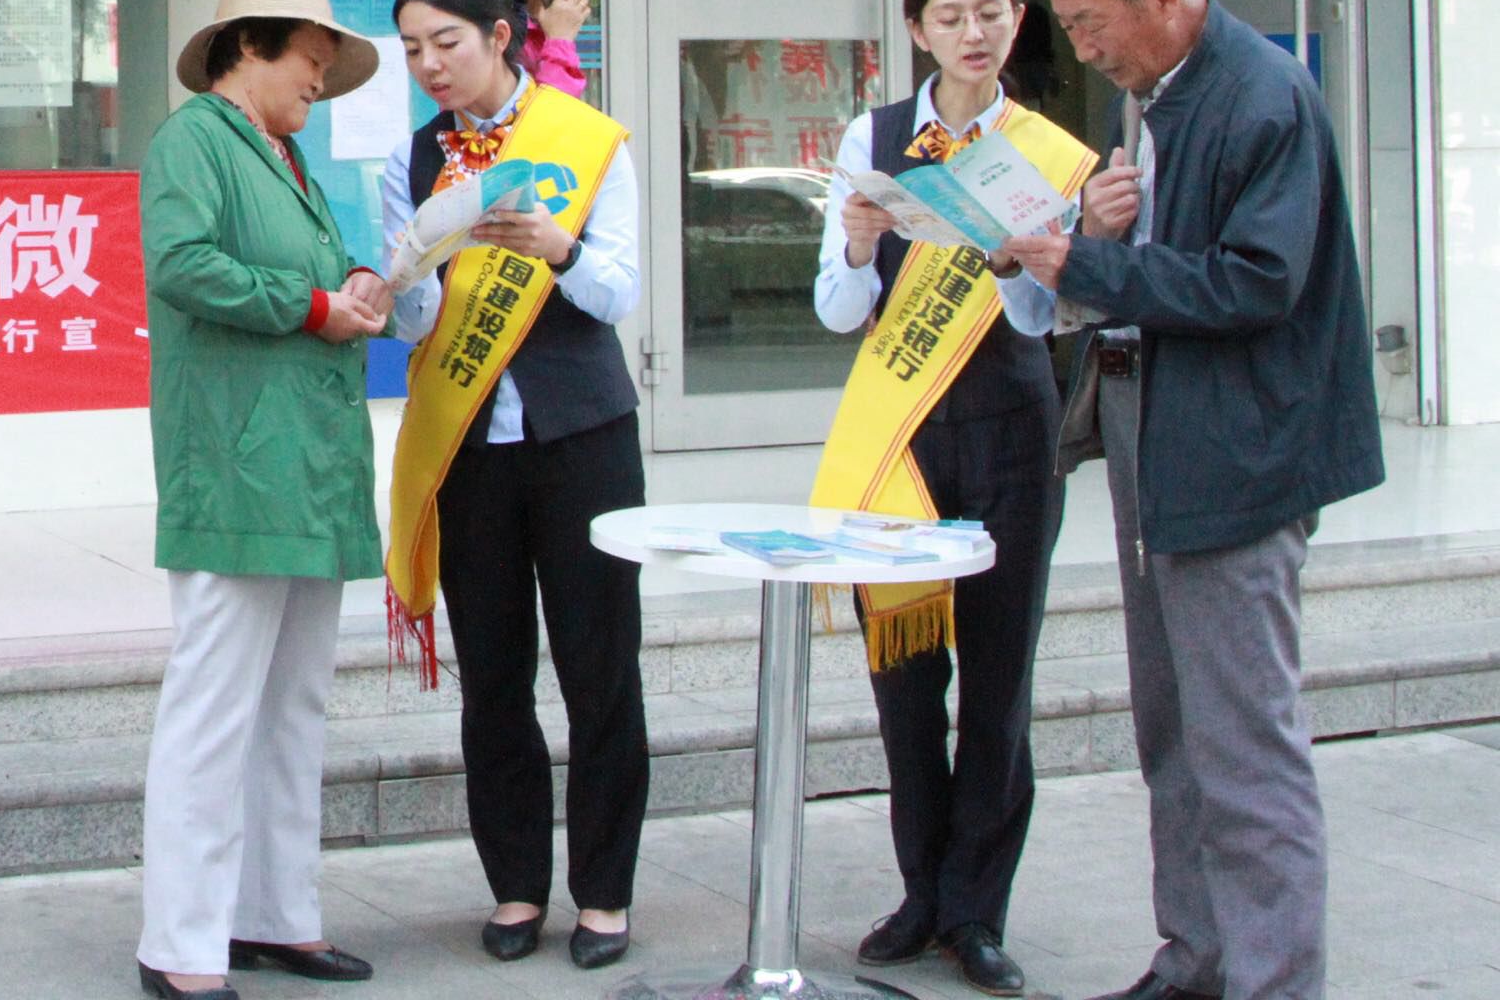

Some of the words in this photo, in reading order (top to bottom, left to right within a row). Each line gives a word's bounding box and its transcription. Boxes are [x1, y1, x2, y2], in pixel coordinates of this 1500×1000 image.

[61, 316, 97, 351] 宣
[449, 255, 536, 389] 国建设银行
